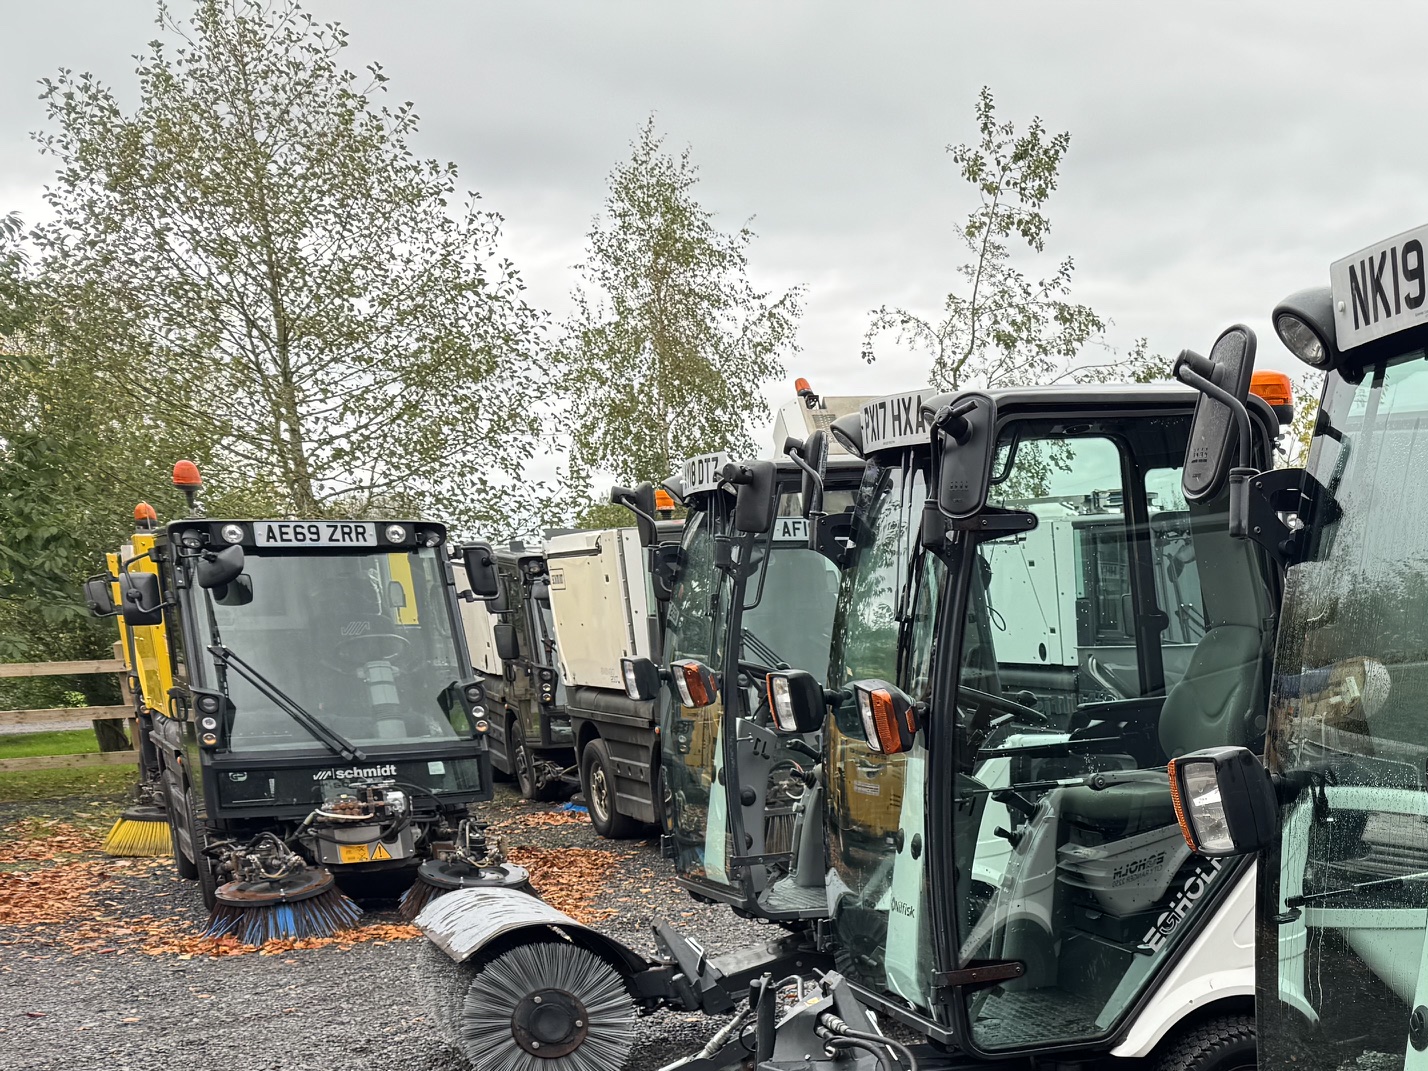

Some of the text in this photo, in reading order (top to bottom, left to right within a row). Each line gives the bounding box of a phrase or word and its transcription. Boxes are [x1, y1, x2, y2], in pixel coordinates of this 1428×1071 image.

[1348, 239, 1426, 331] NK19
[864, 394, 926, 444] PX17 HXA
[265, 524, 368, 542] AE69 ZRR
[782, 521, 810, 537] AF1
[335, 764, 397, 779] schmidt
